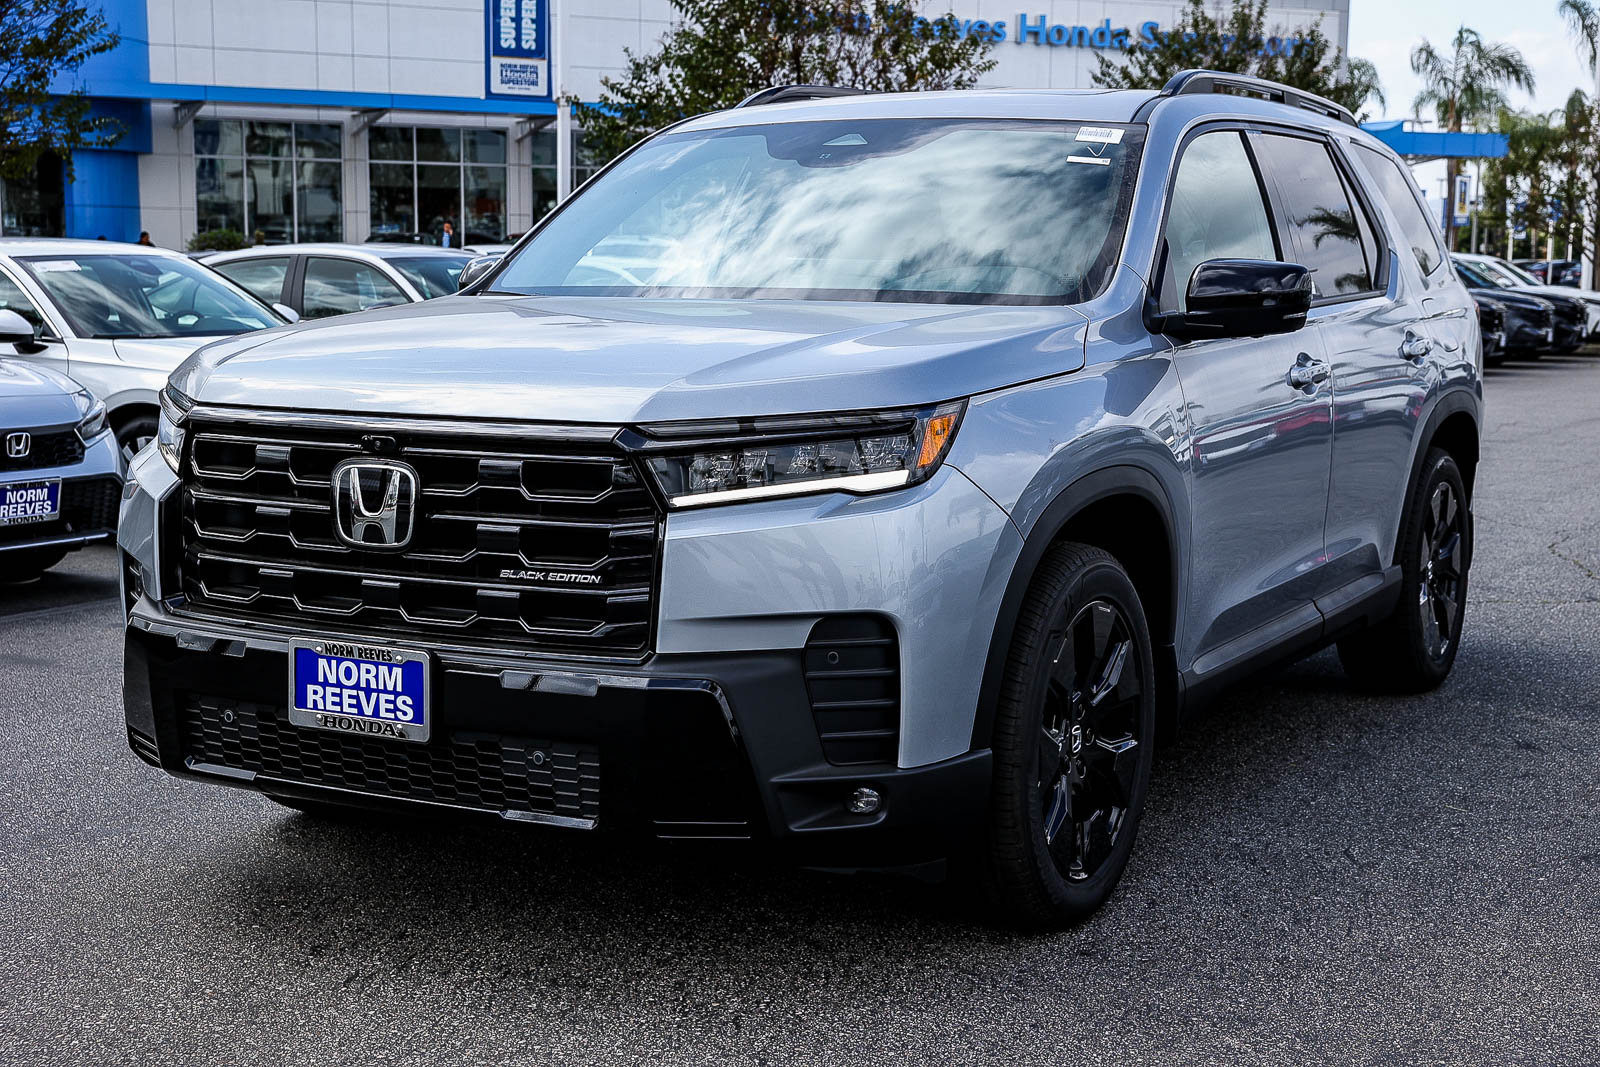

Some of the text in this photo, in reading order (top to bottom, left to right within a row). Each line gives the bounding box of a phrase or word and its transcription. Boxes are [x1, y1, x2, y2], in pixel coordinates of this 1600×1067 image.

[1018, 13, 1129, 48] Honda
[6, 488, 48, 504] NORM
[0, 500, 52, 518] REEVES
[500, 569, 601, 583] BLACK EDITION
[325, 643, 393, 662] NORM REEVES
[318, 658, 403, 692] NORM
[306, 684, 414, 721] REEVES
[322, 715, 400, 737] HONDA
